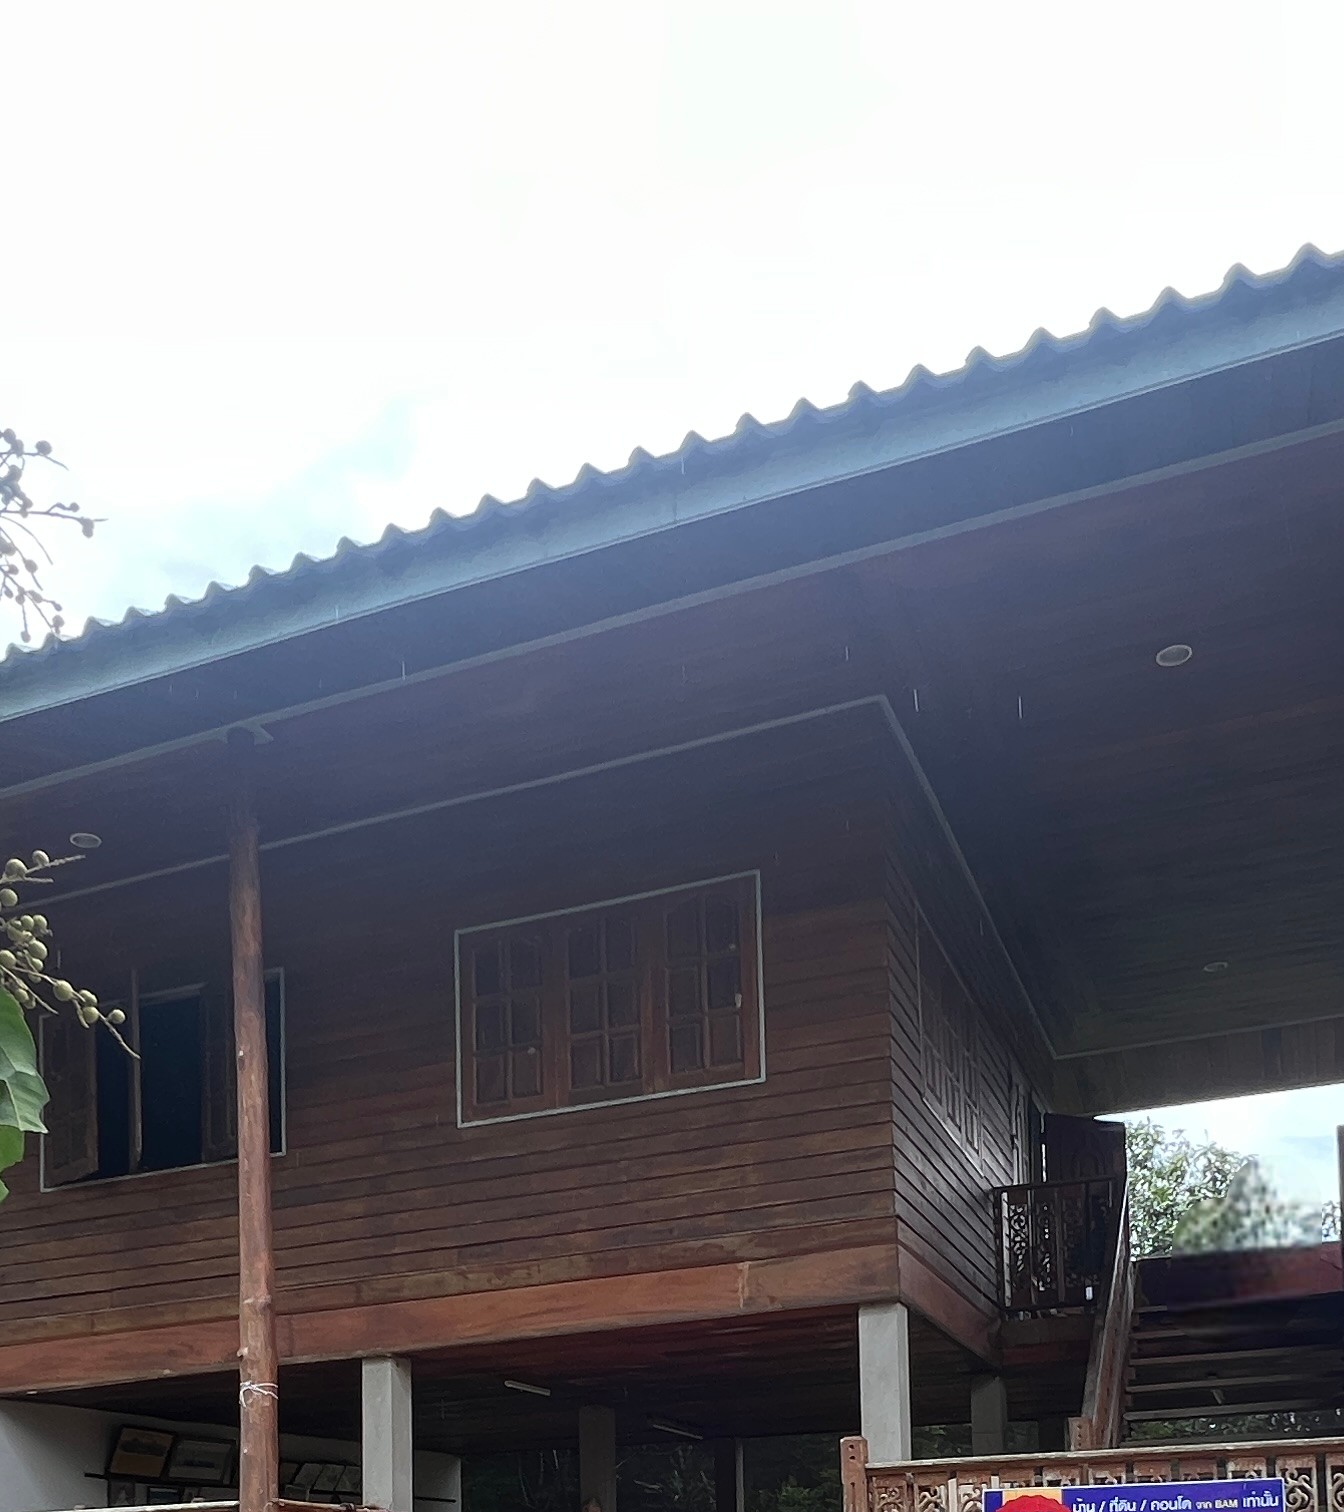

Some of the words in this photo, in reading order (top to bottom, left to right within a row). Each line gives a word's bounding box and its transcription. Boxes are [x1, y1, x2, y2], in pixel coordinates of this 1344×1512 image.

[1150, 1495, 1192, 1511] คอนโด
[1214, 1498, 1239, 1509] BAM
[1242, 1491, 1280, 1508] เท่านั้น
